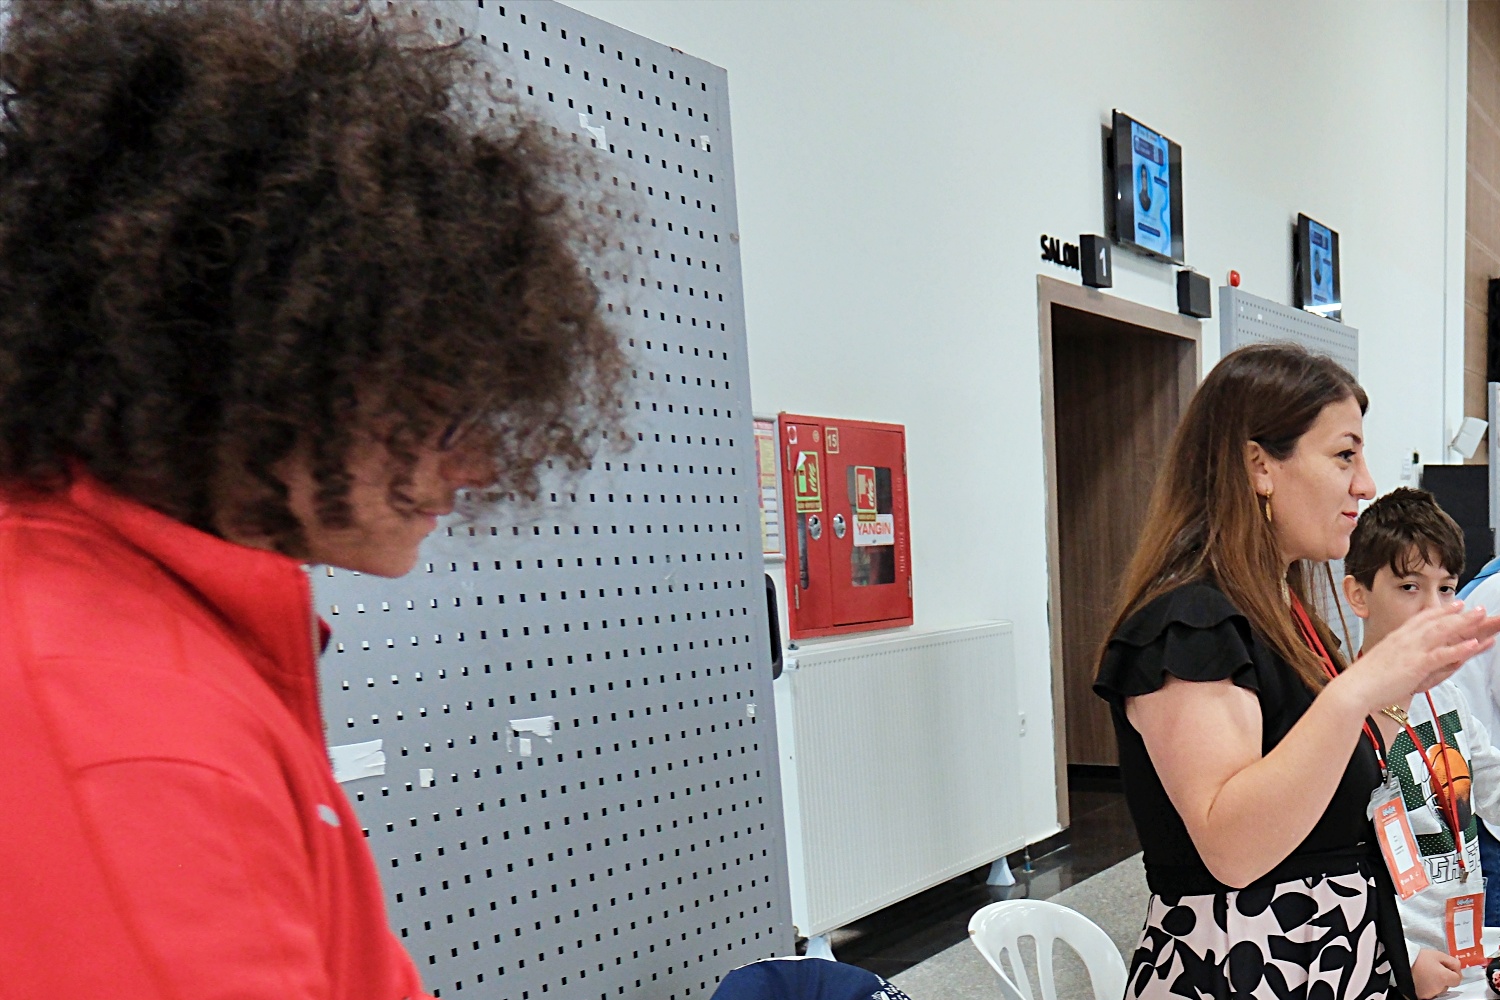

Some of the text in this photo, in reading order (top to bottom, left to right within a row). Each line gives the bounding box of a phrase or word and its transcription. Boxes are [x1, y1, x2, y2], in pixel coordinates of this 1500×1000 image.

[1041, 234, 1107, 277] SALON 1
[827, 433, 838, 448] 15
[856, 522, 892, 536] YANGIN
